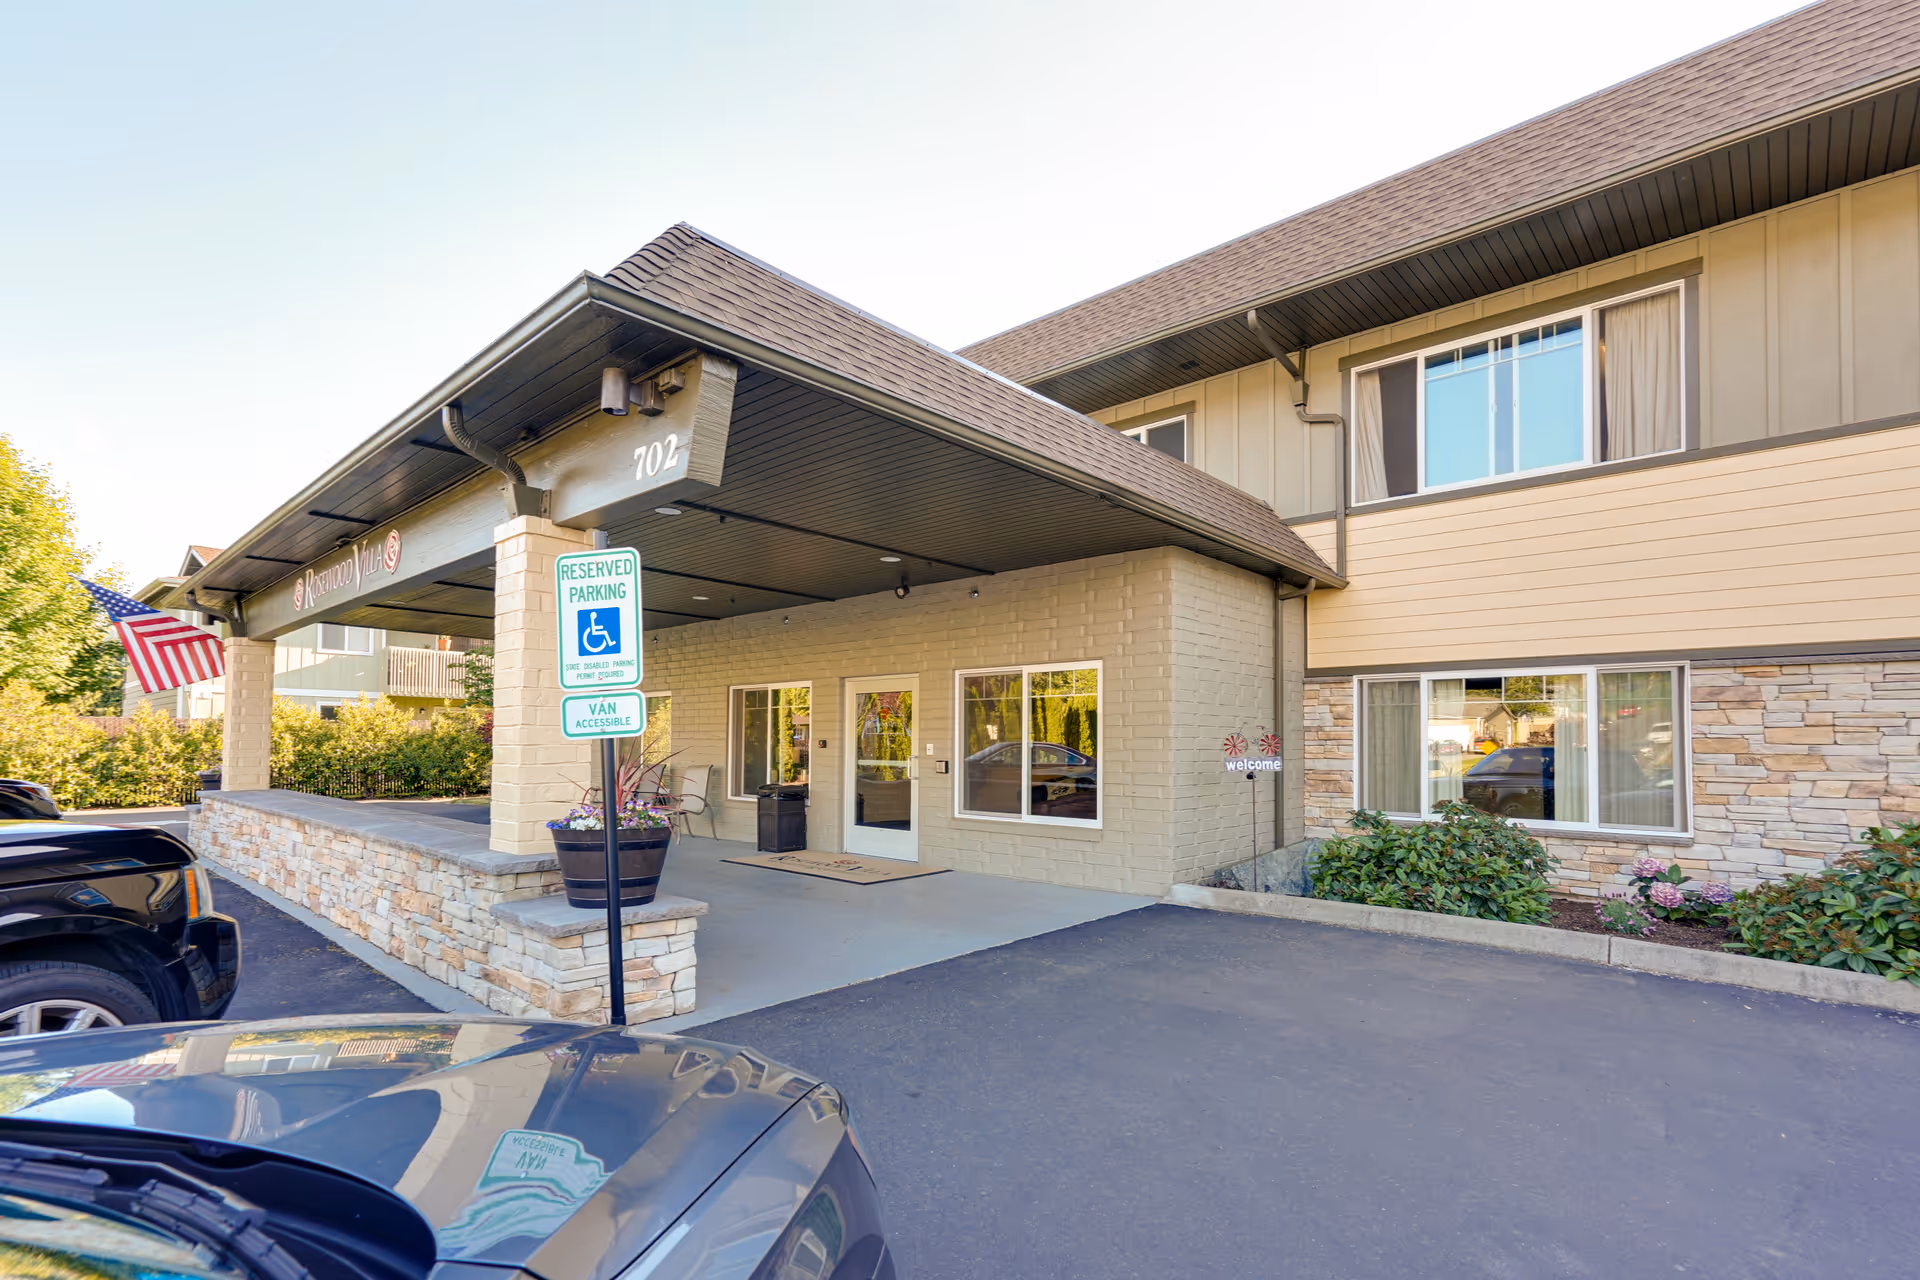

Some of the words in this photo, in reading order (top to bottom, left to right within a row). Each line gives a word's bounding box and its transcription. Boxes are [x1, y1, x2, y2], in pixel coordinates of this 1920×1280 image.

[634, 433, 678, 480] 702
[561, 559, 633, 580] RESERVED
[569, 583, 627, 603] PARKING
[566, 663, 580, 671] STATE
[584, 661, 609, 670] DISABLED
[613, 659, 635, 667] PARKING
[576, 672, 595, 680] PERMIT
[598, 670, 624, 679] REQUIRED
[588, 702, 617, 715] VAN
[575, 717, 631, 729] ACCESSIBLE
[1226, 759, 1281, 771] welcome
